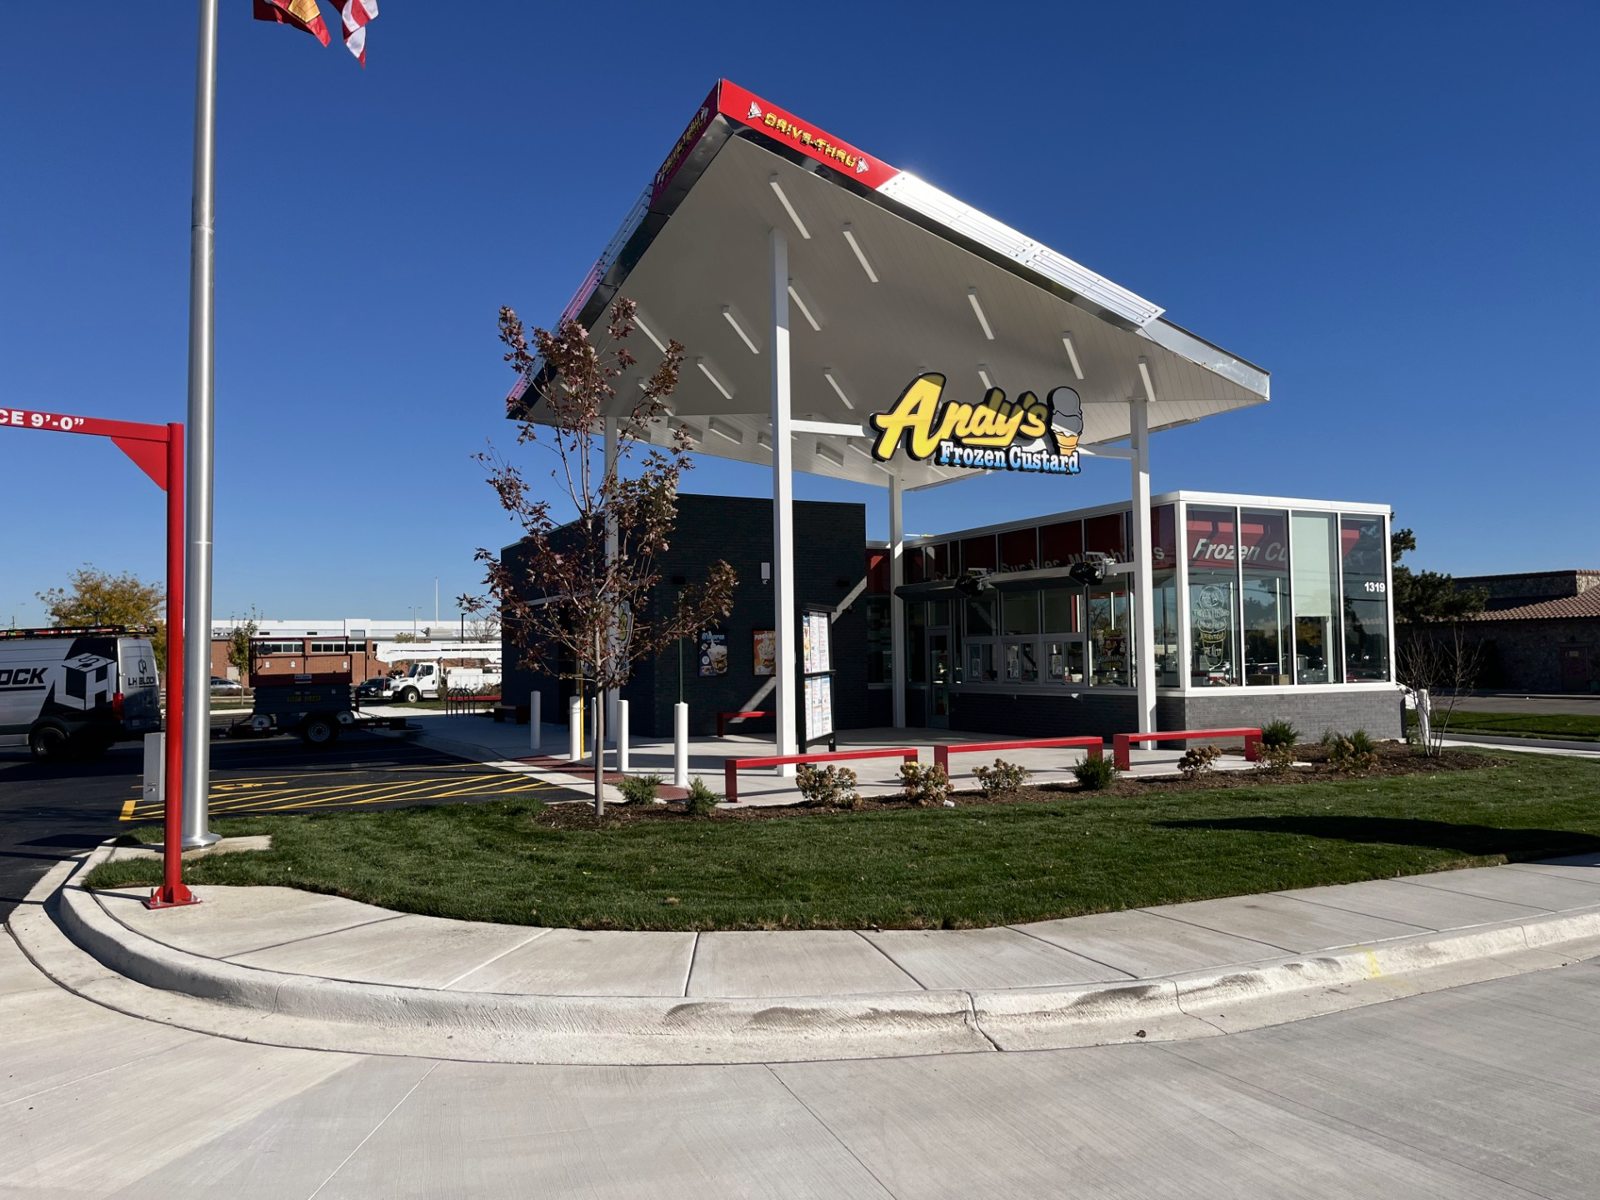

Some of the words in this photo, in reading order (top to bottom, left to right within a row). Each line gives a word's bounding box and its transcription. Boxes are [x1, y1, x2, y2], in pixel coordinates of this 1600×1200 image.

[763, 111, 857, 168] DRIVE-THRU
[872, 372, 1048, 461] Andy's
[939, 440, 1007, 470] Frozen
[1008, 446, 1081, 474] Custard
[1192, 538, 1261, 561] Frozen
[1364, 581, 1386, 593] 1319
